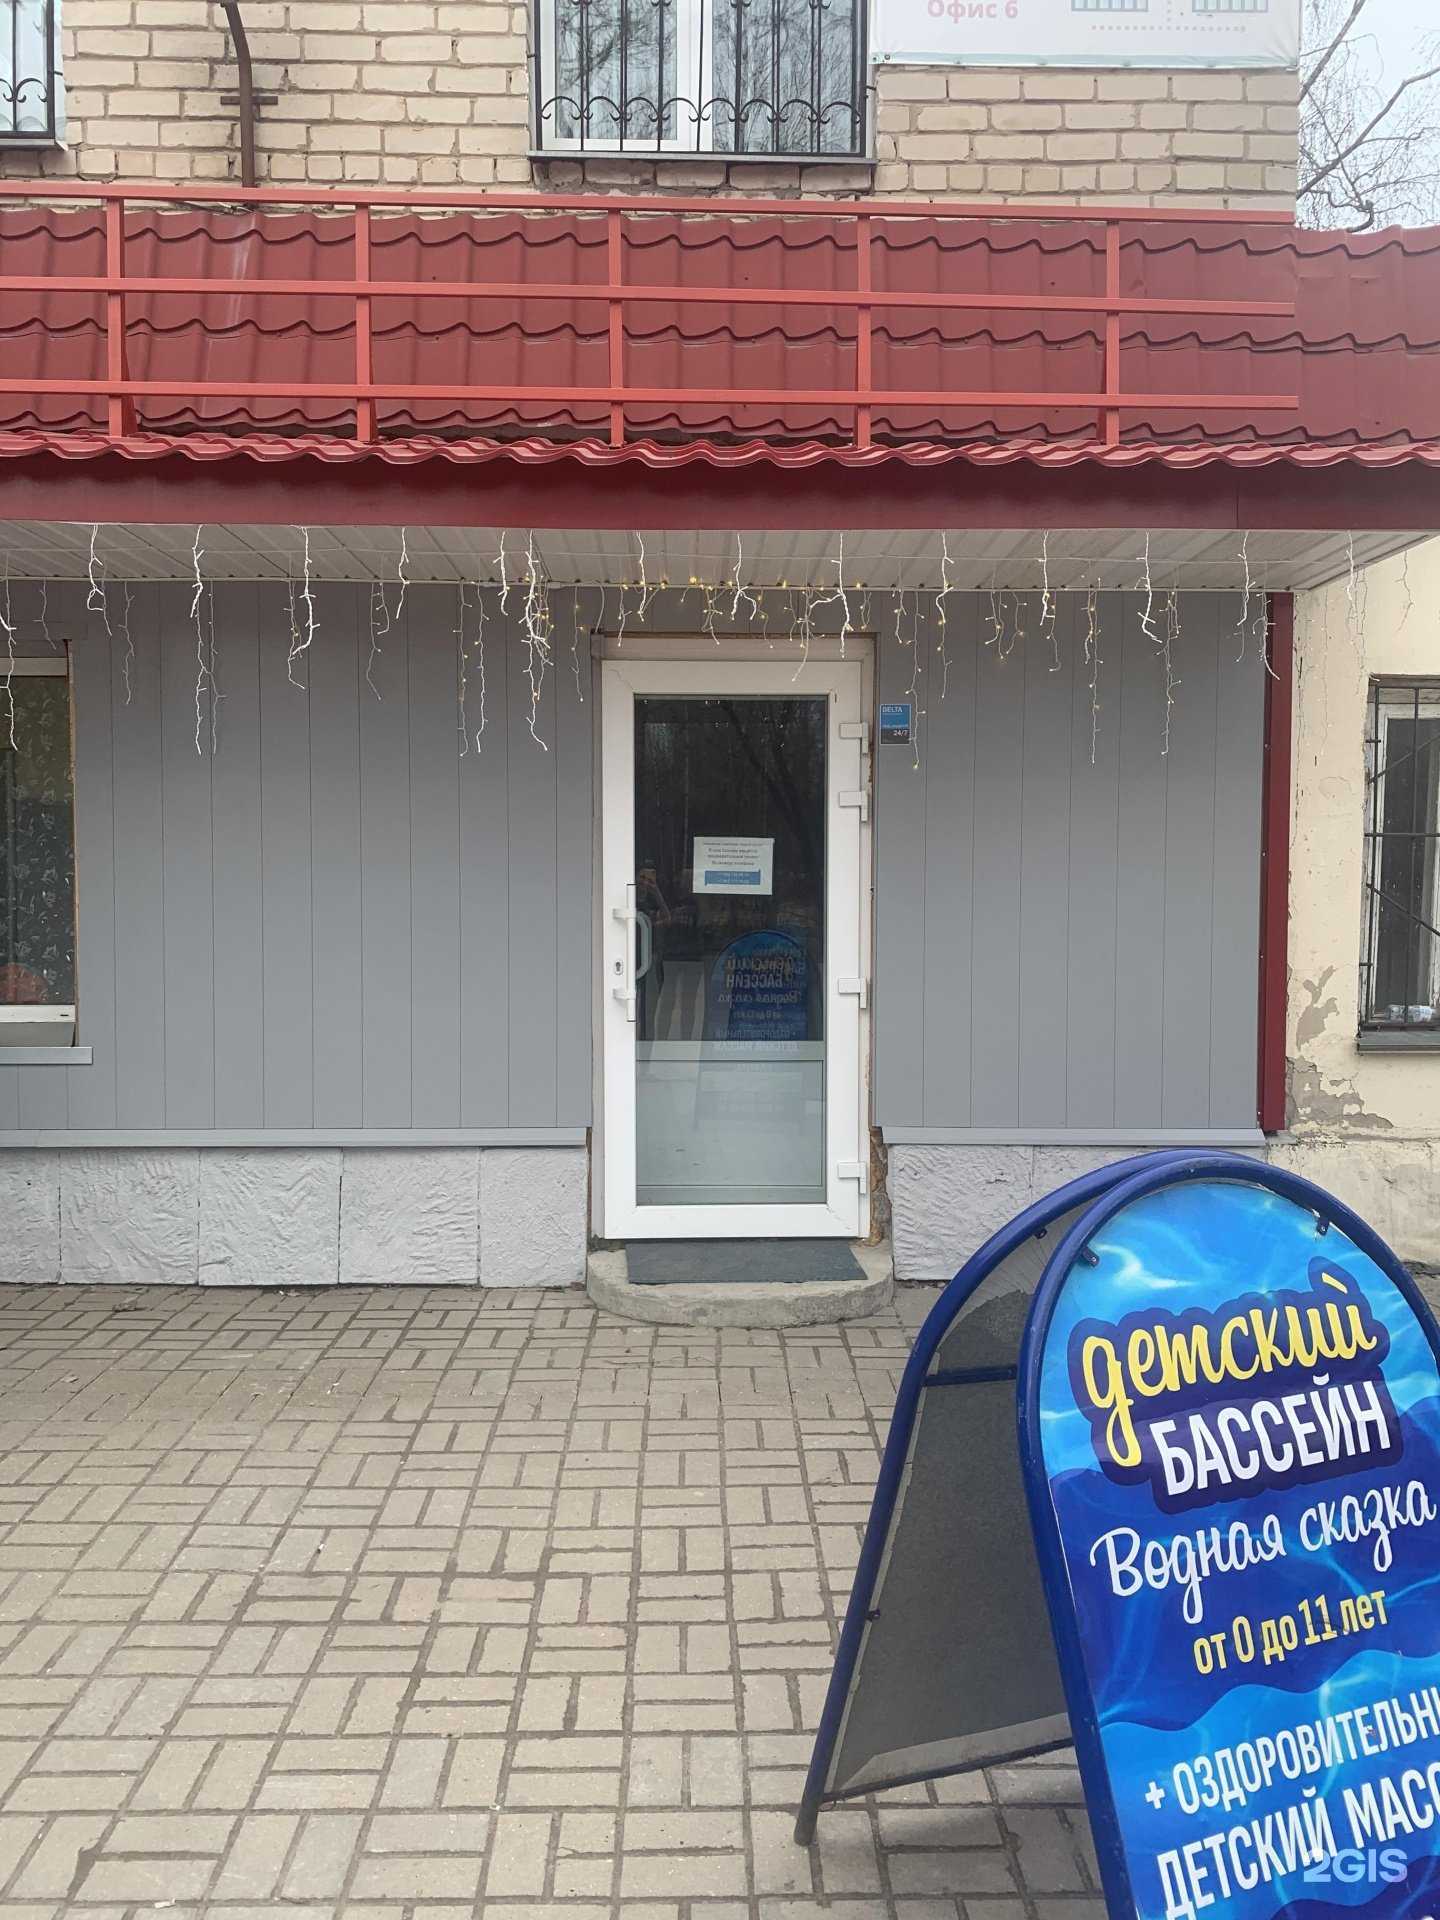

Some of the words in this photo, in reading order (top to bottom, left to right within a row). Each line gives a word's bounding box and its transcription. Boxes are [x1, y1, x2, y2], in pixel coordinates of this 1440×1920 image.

[927, 0, 998, 24] Офис
[1004, 0, 1019, 19] 6
[893, 729, 909, 737] 24/7
[1149, 1374, 1392, 1497] БАССЕЙН
[1089, 1513, 1287, 1625] Водная
[1300, 1479, 1438, 1573] сказка
[1193, 1632, 1228, 1675] от
[1232, 1615, 1255, 1664] 0
[1260, 1613, 1299, 1665] до
[1298, 1594, 1339, 1647] 11
[1339, 1590, 1390, 1636] лет
[1156, 1785, 1339, 1920] ДЕТСКИЙ
